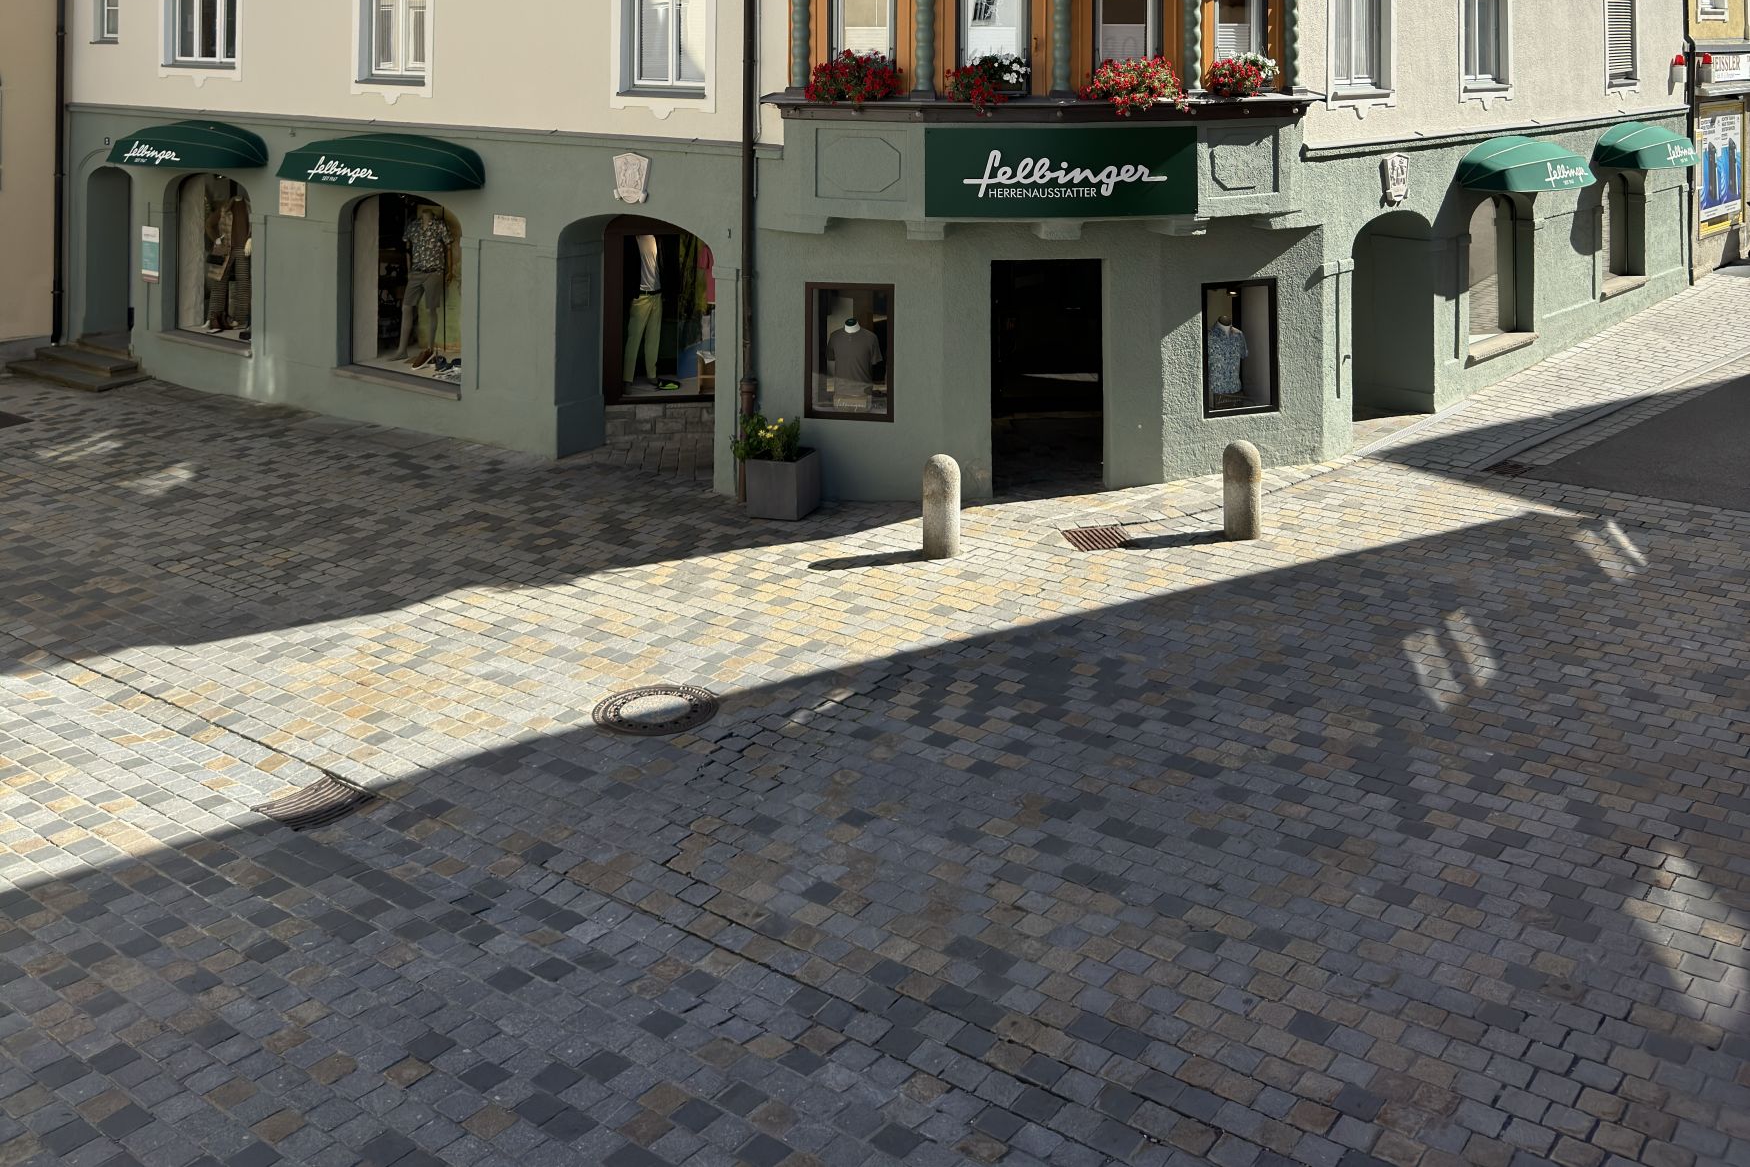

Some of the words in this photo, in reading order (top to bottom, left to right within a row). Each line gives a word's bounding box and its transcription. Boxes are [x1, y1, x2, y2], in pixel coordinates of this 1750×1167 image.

[124, 141, 181, 165] felbinger
[307, 155, 379, 184] felbinger
[963, 150, 1168, 197] felbinger
[988, 187, 1097, 198] HERRENAUSSTATTER
